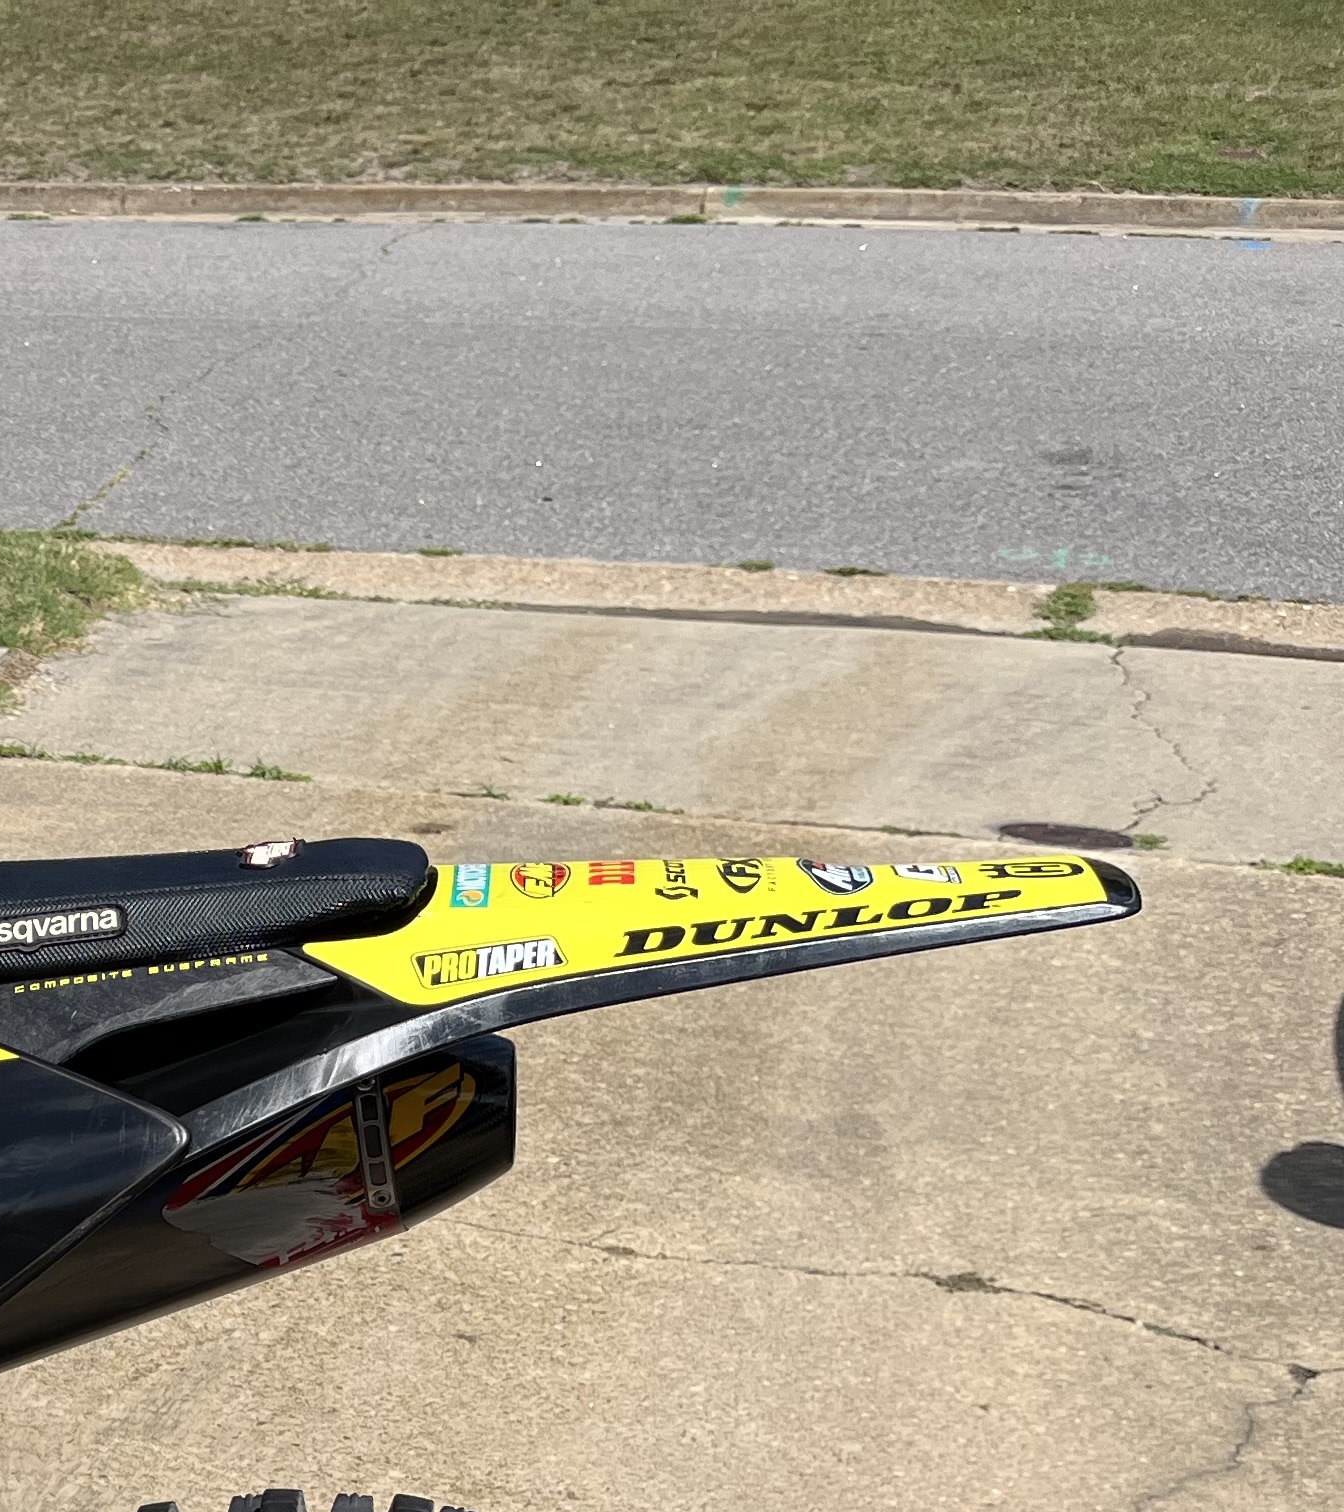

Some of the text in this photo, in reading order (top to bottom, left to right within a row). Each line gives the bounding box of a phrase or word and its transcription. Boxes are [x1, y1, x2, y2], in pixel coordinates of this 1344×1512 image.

[613, 889, 1021, 957] DUNLOP
[14, 969, 133, 994] COMPOSITE
[424, 938, 558, 987] PROTAPER
